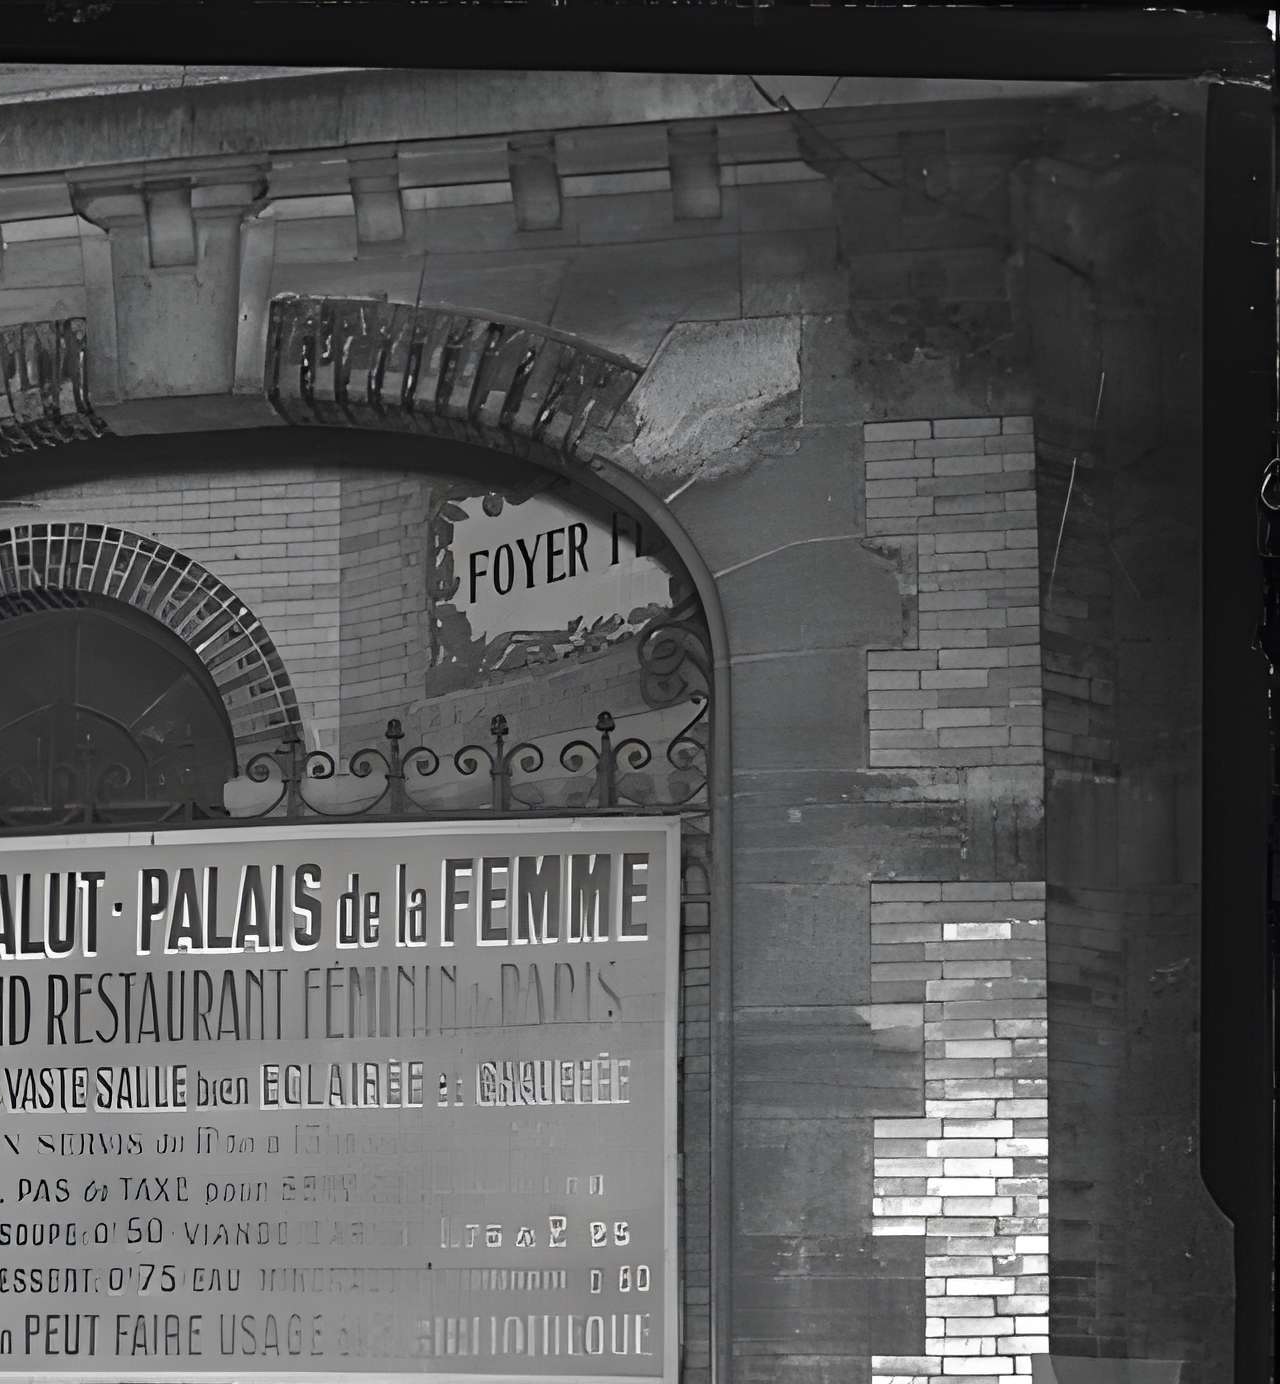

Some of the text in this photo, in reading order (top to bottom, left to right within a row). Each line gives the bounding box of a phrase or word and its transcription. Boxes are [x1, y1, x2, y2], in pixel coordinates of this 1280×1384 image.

[469, 522, 589, 604] FOYER
[136, 863, 322, 955] PALAIS
[336, 873, 380, 949] de
[395, 863, 428, 948] la
[440, 852, 650, 947] FEMME
[47, 968, 289, 1045] RESTAURANT
[3, 1066, 88, 1113] VASTE
[95, 1064, 188, 1113] SALLE
[24, 1313, 101, 1356] PEUT
[114, 1313, 203, 1357] FAIRE
[220, 1313, 324, 1356] USAGE
